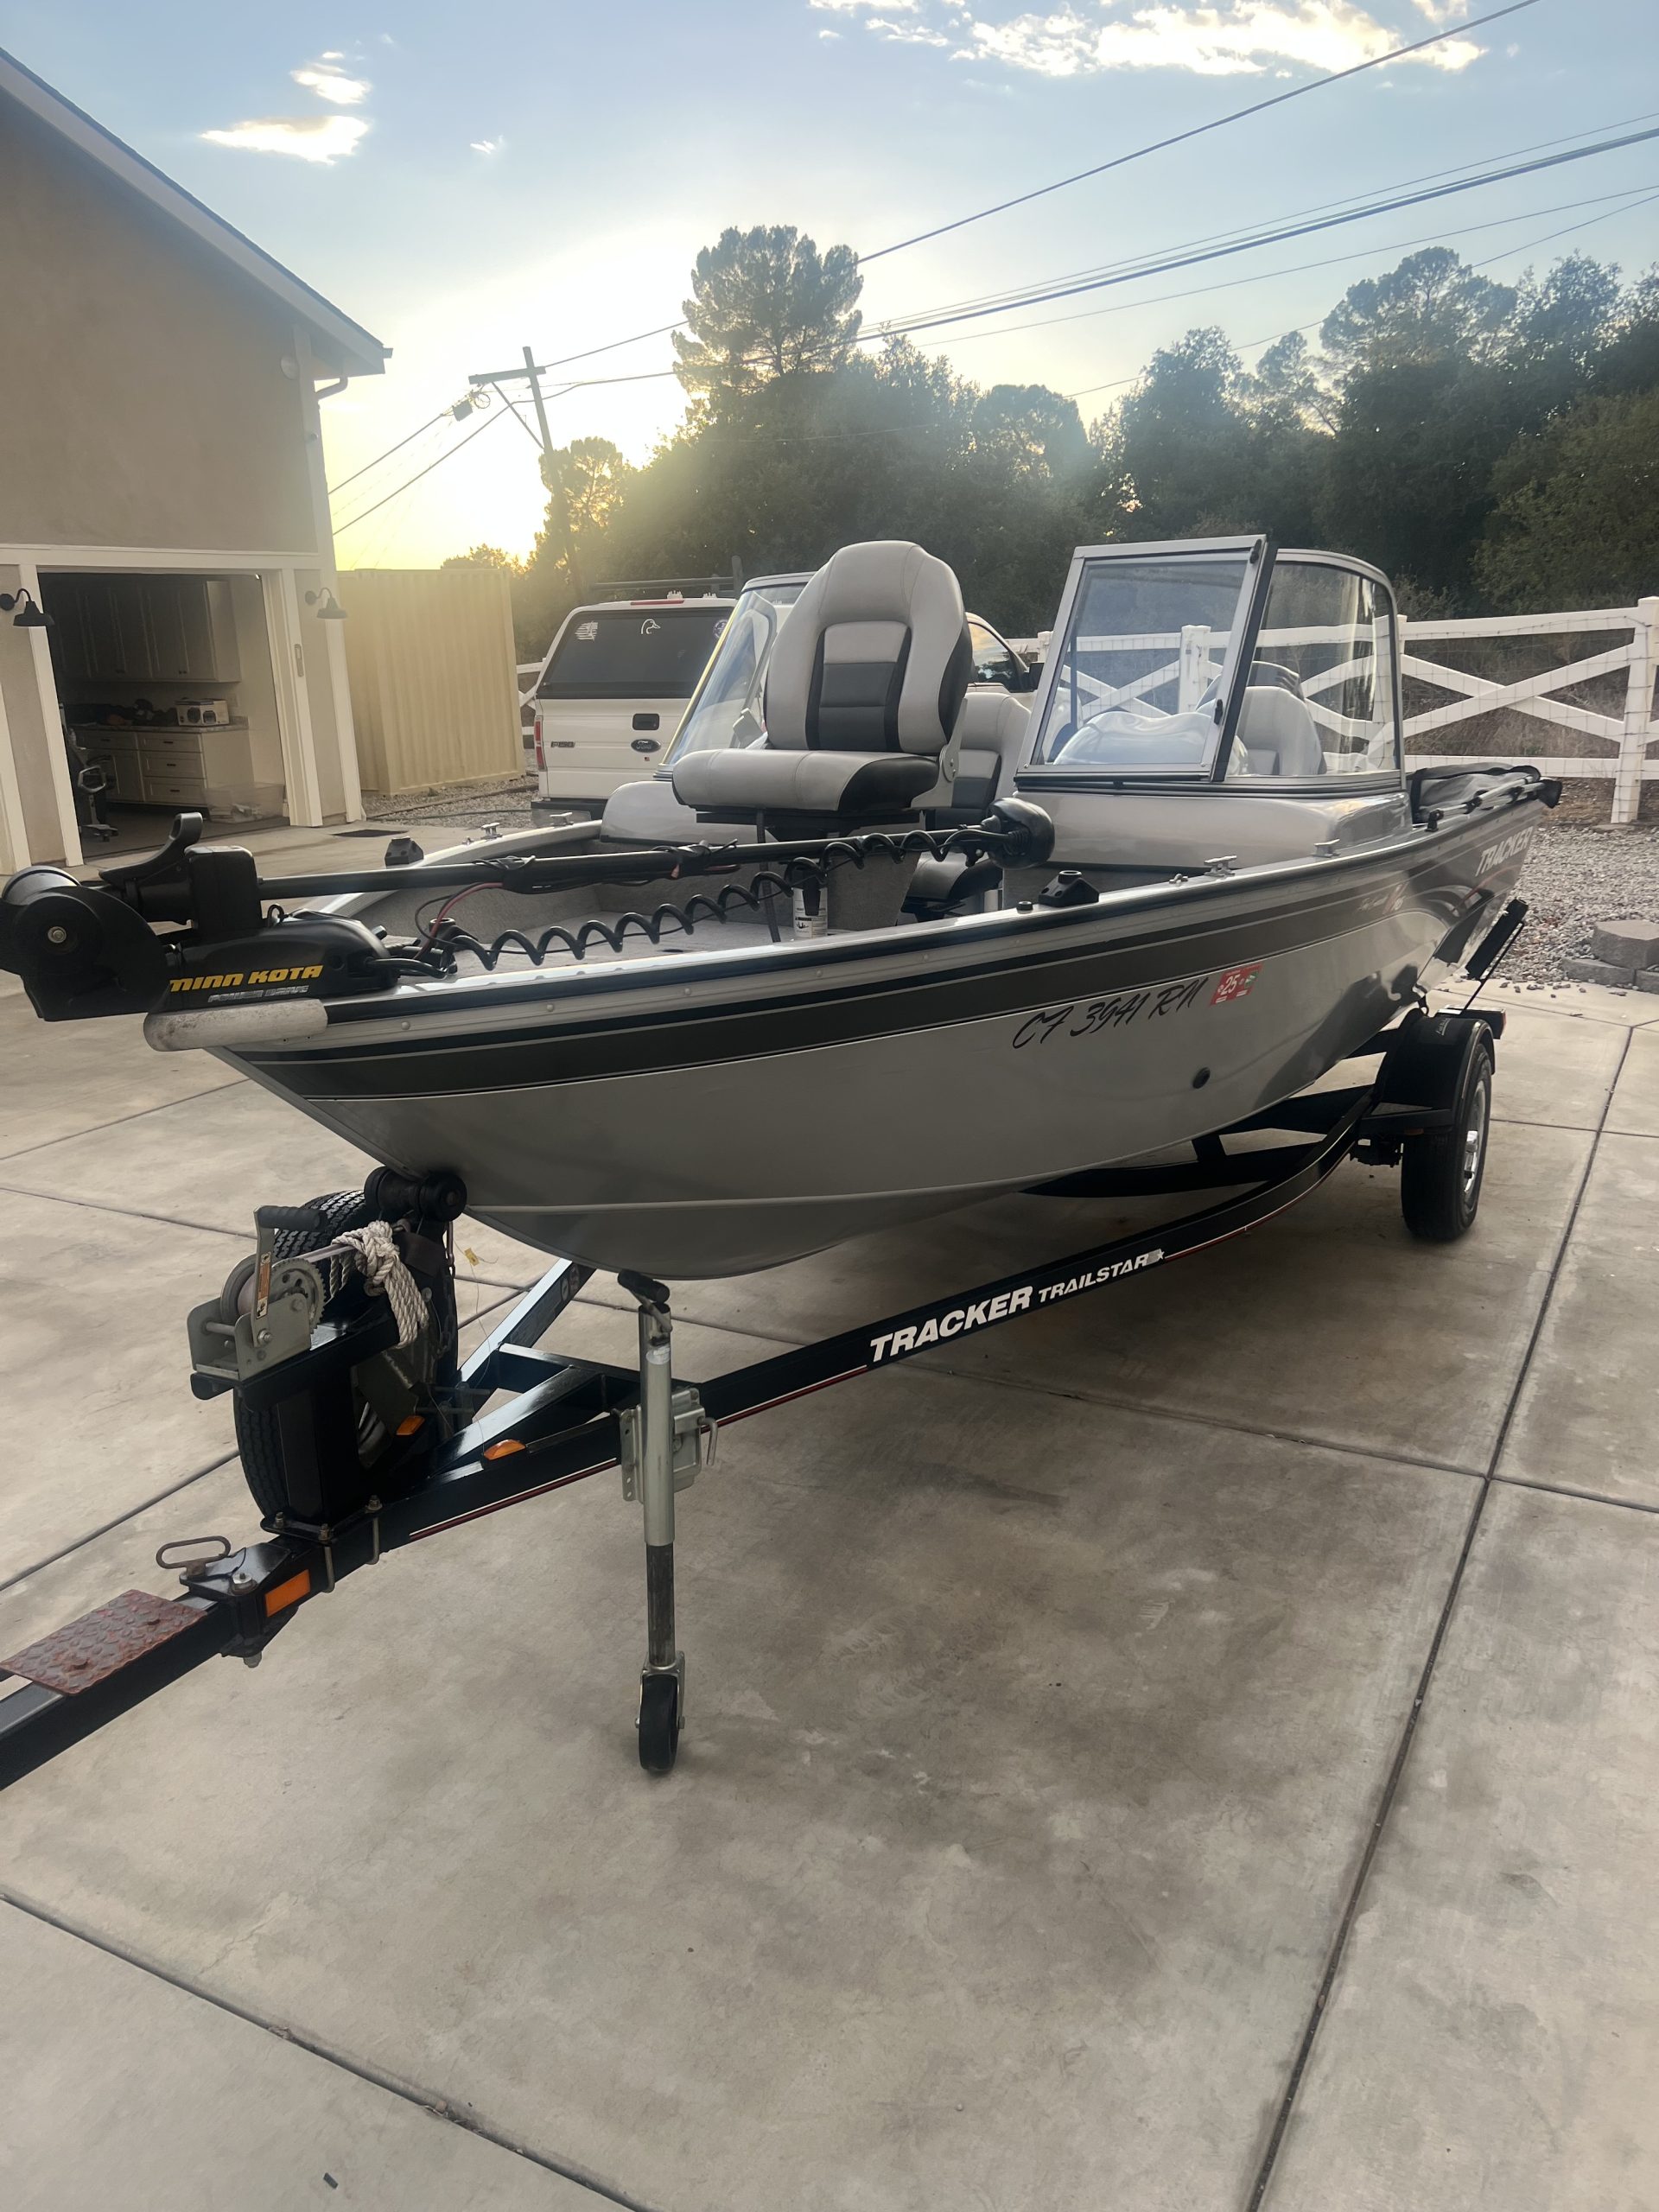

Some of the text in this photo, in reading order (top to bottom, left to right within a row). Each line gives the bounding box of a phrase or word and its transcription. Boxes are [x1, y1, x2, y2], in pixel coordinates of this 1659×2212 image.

[1475, 826, 1534, 877] TRACKER
[169, 965, 324, 992] MINN KOTA
[1220, 974, 1241, 995] 25
[1012, 1006, 1075, 1049] CF
[1070, 992, 1151, 1037] 3941
[870, 1254, 1149, 1363] TRACKER TRAILSTAR
